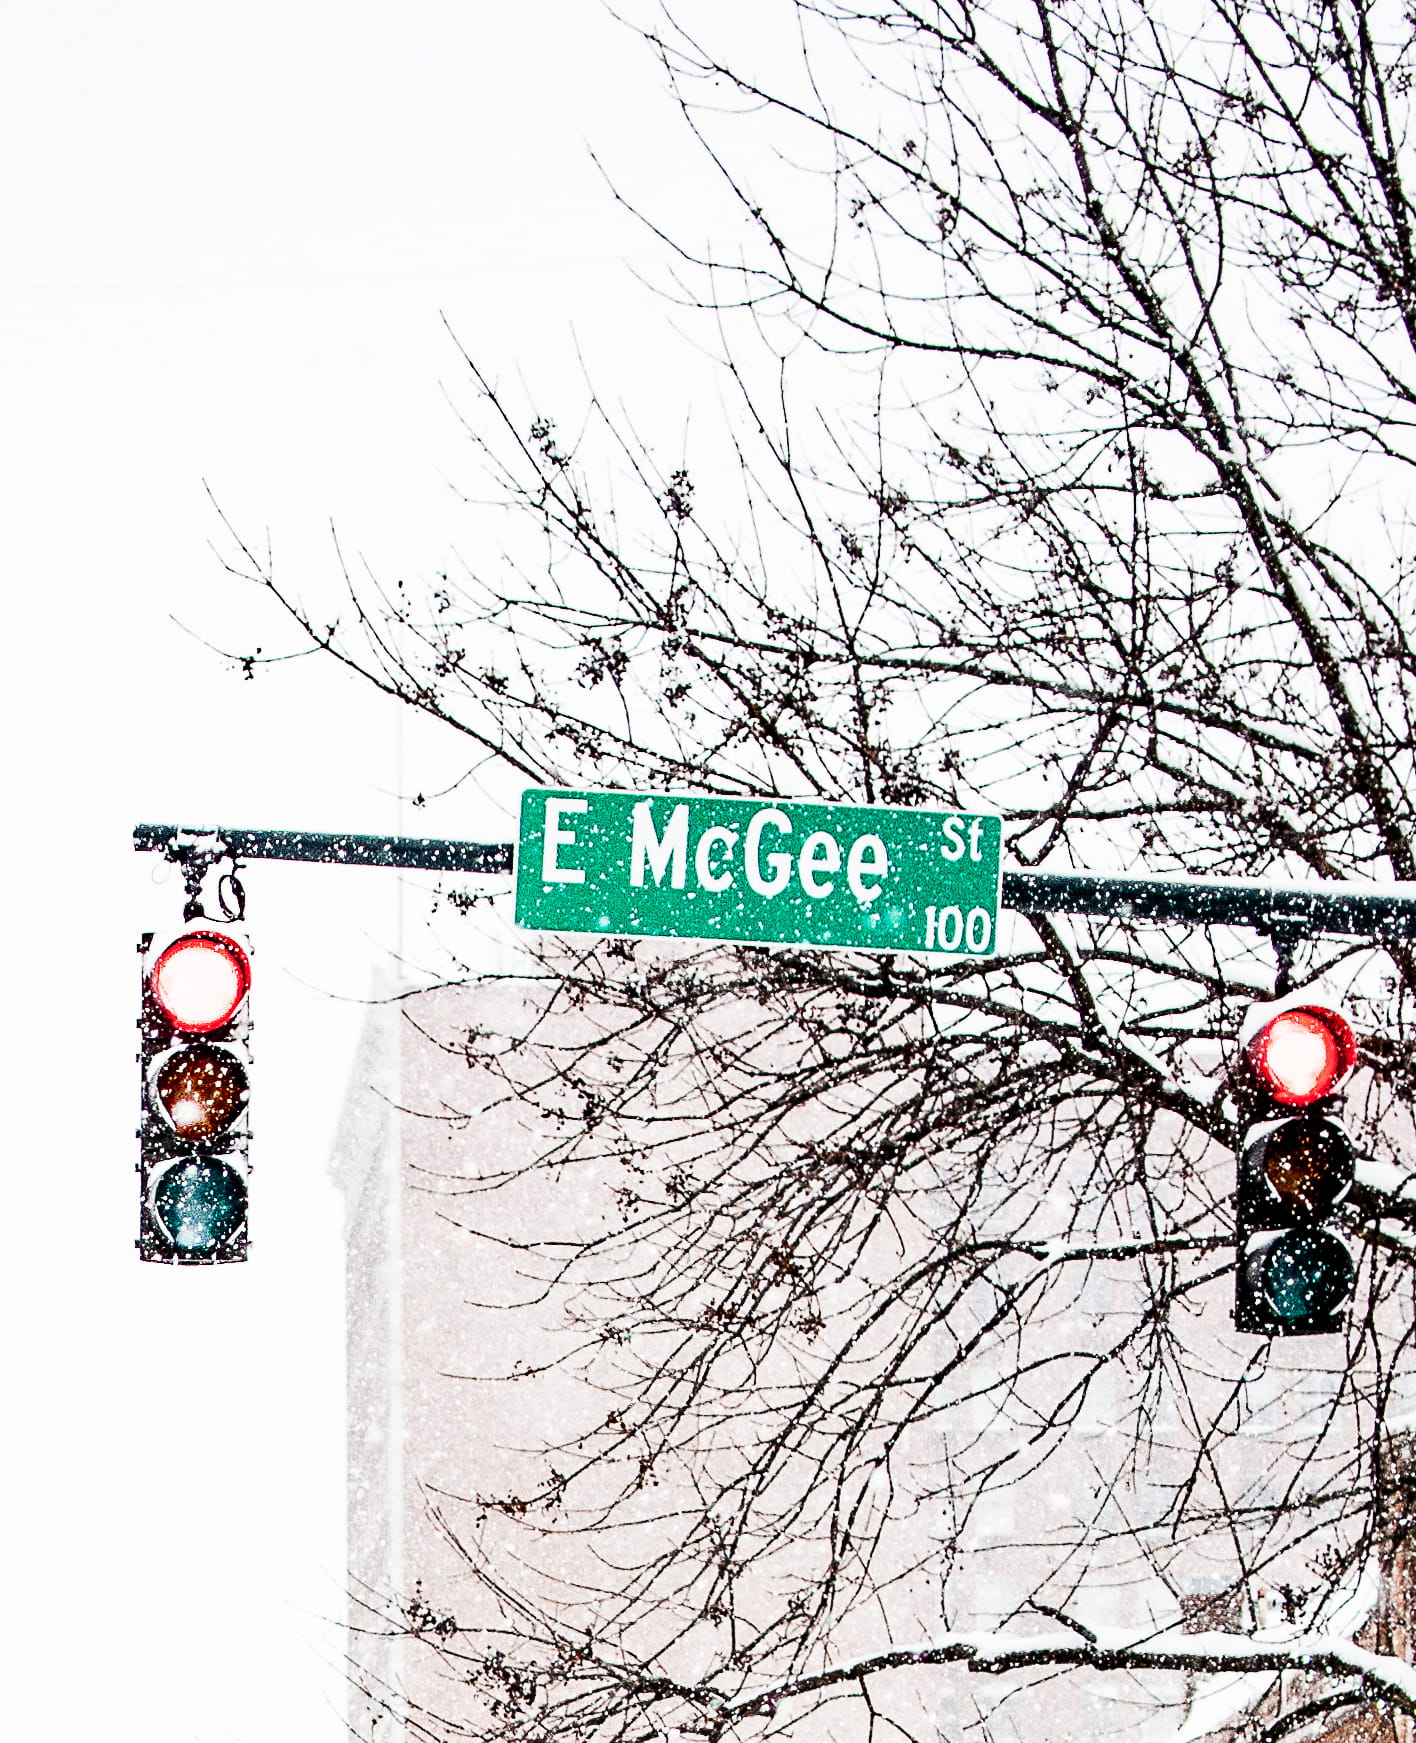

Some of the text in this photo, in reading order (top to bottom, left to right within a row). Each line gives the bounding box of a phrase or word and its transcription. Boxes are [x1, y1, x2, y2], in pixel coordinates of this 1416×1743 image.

[542, 797, 984, 902] E McGee St
[924, 906, 992, 953] 100
